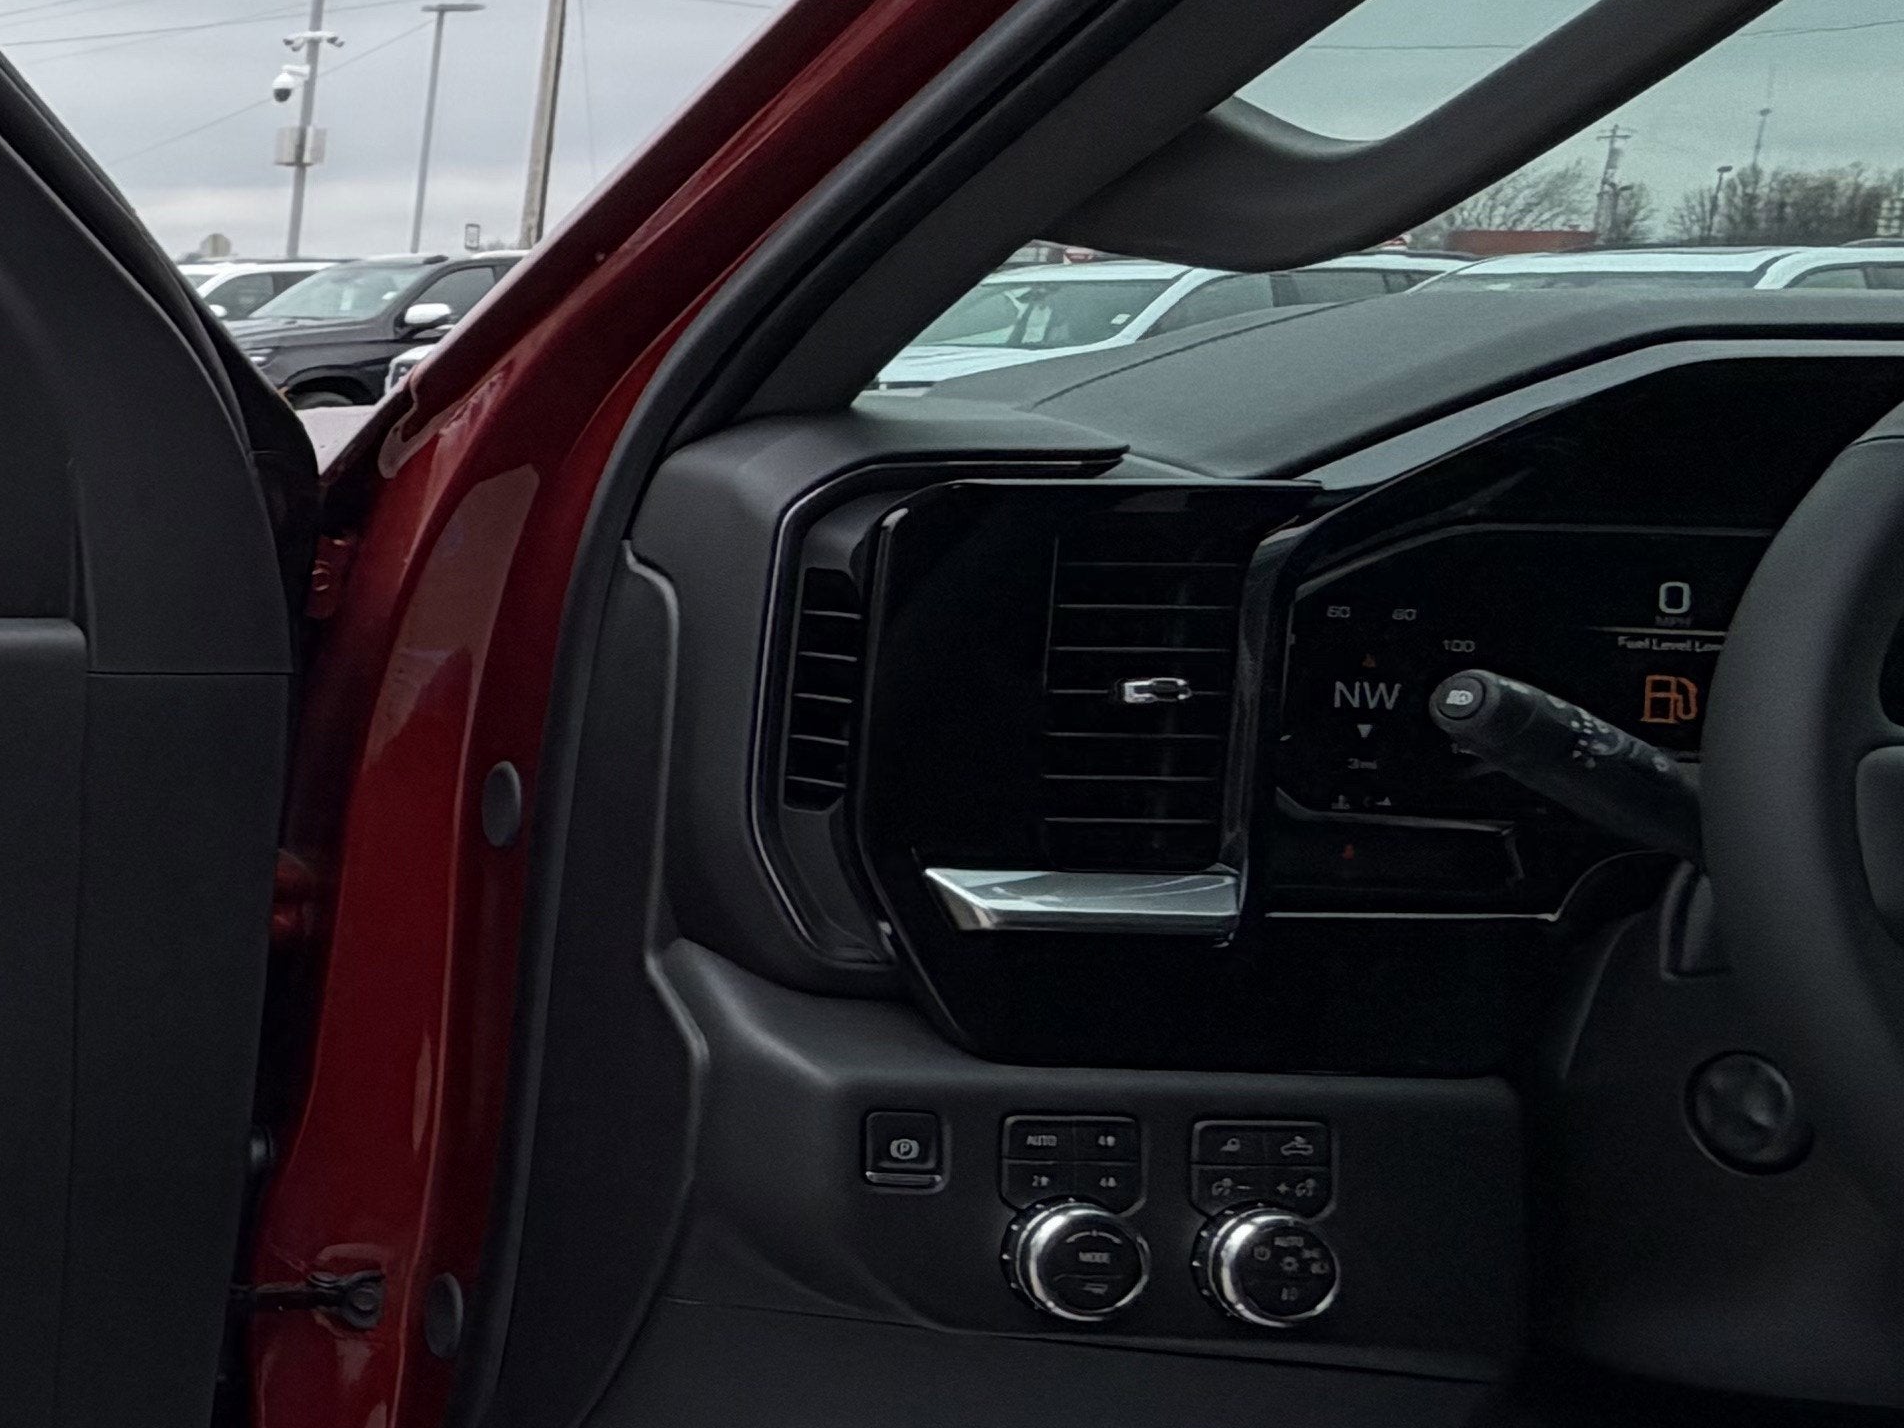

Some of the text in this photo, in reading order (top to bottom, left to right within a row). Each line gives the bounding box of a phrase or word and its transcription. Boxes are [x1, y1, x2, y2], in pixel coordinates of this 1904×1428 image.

[1658, 581, 1691, 614] 0
[1617, 635, 1651, 649] Fuel
[1652, 638, 1693, 651] Level
[1333, 680, 1402, 710] NW
[1026, 1134, 1058, 1147] AUTO
